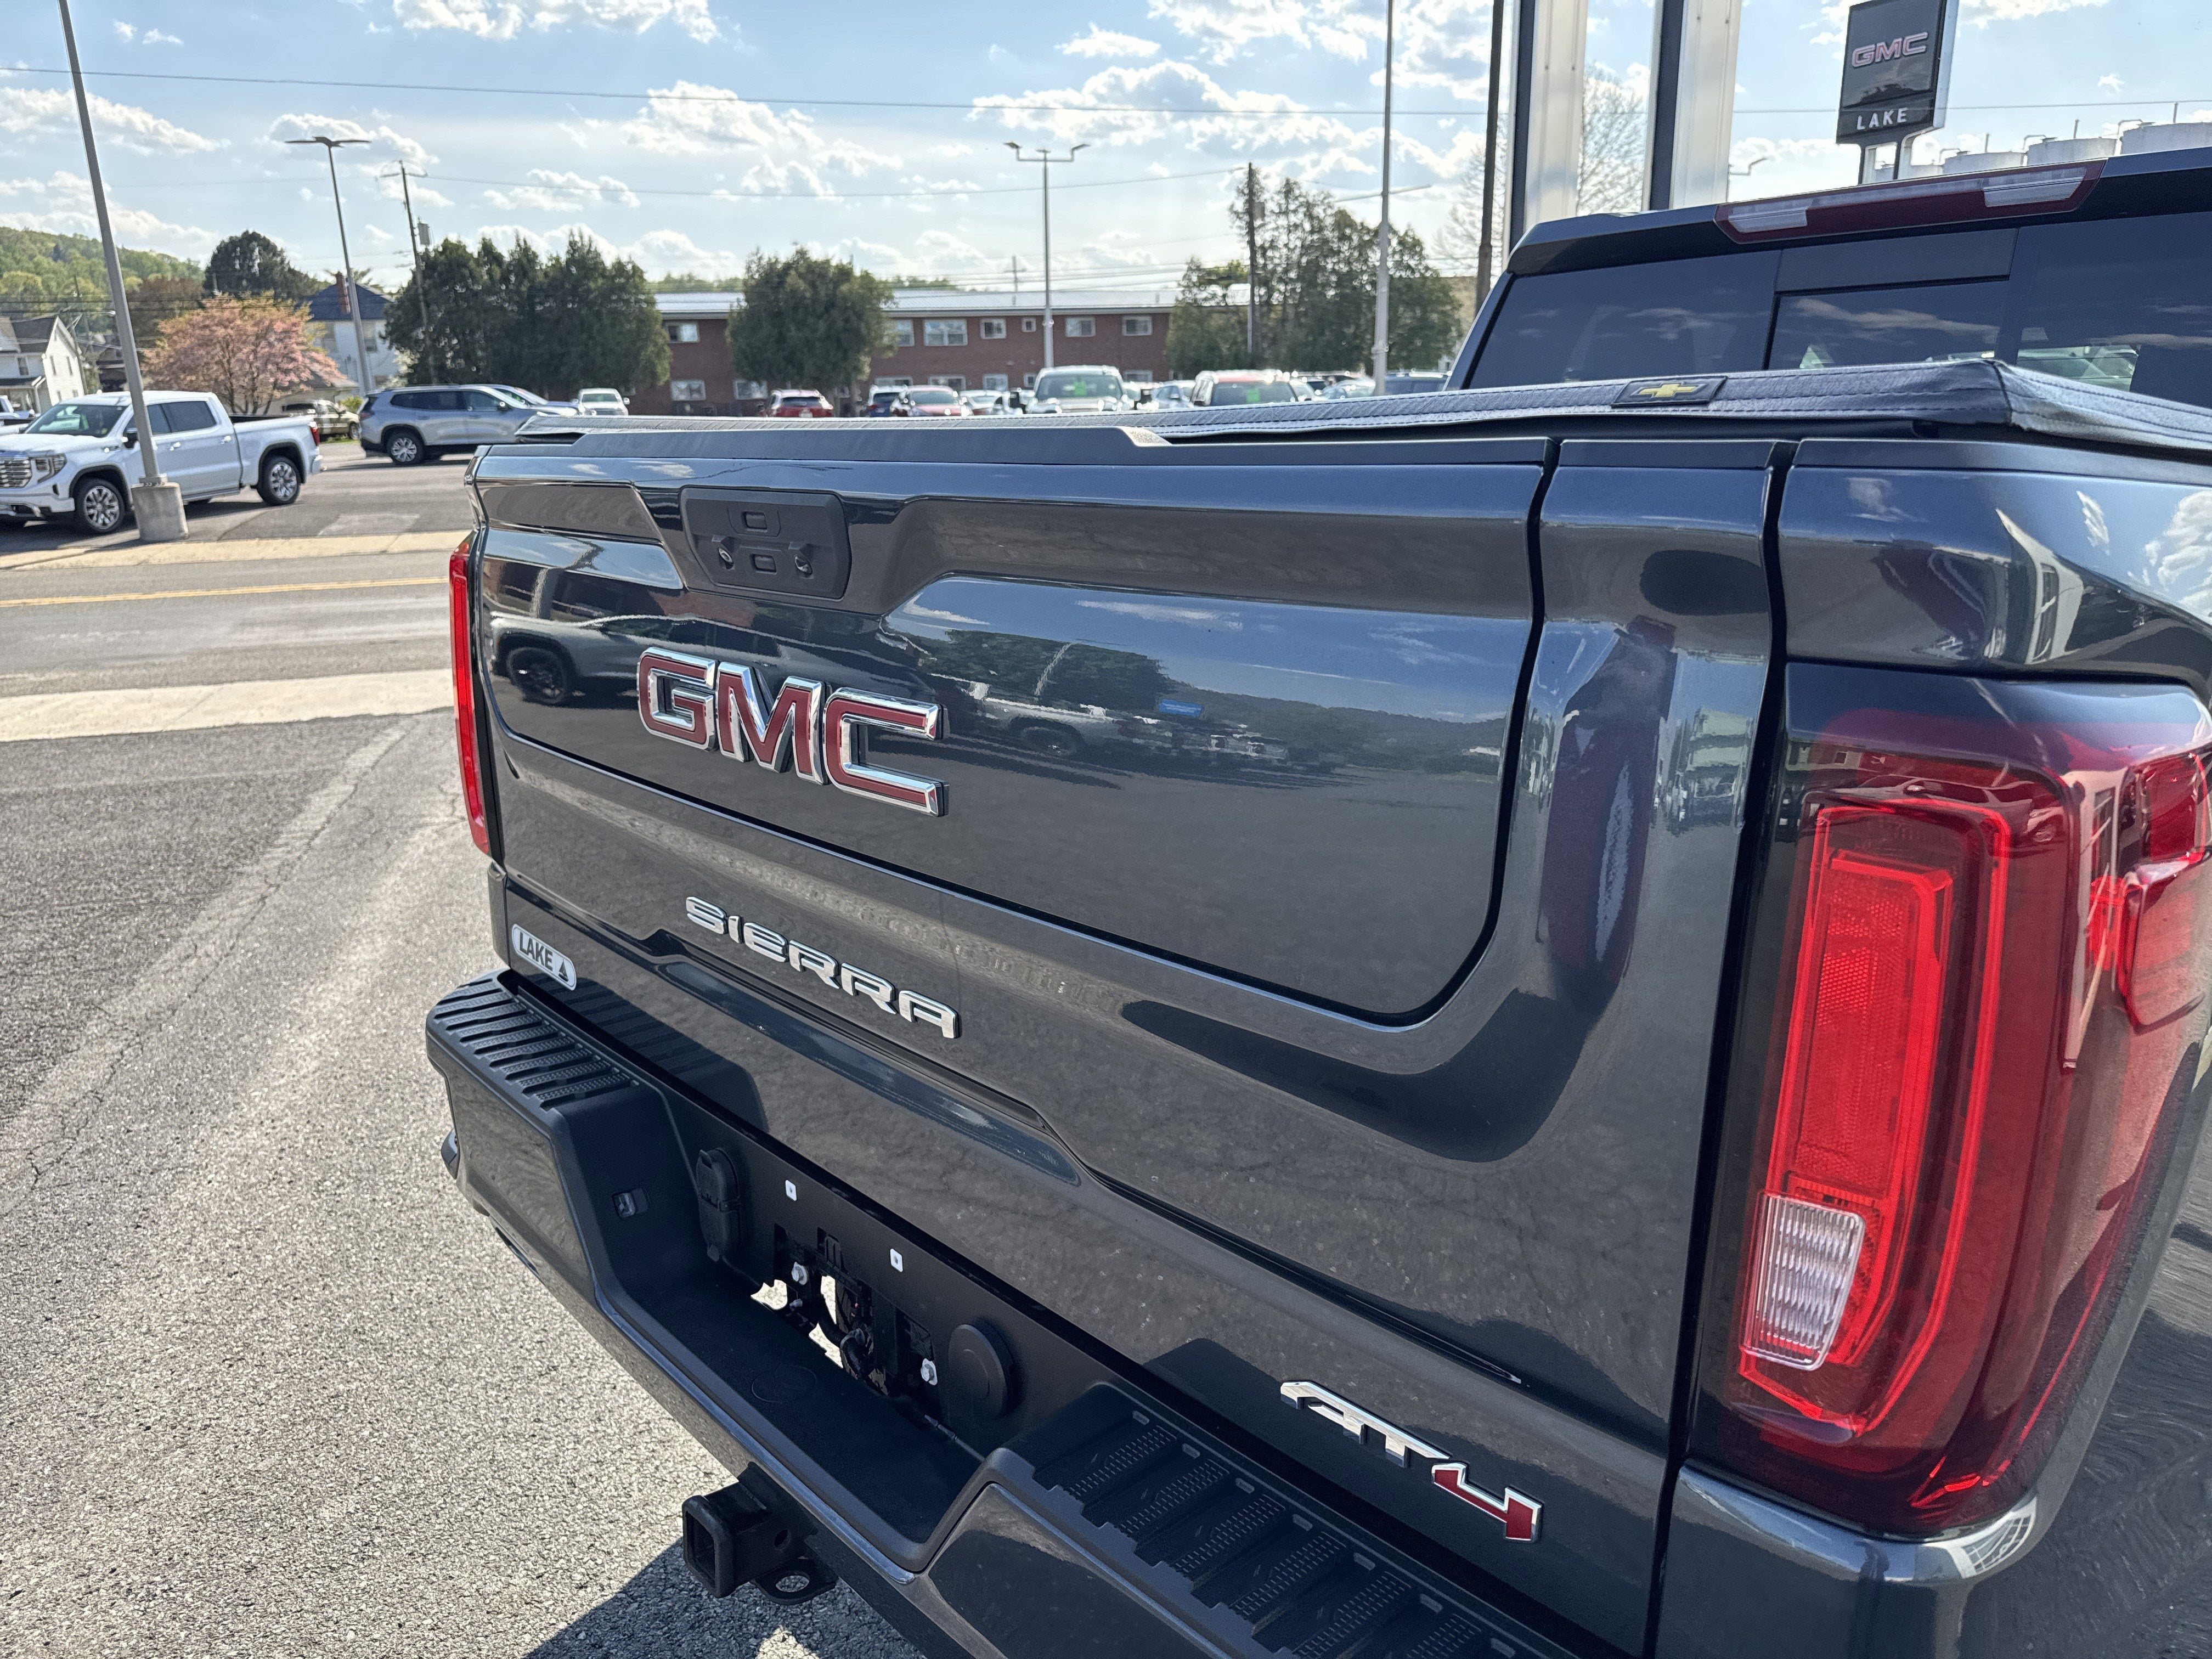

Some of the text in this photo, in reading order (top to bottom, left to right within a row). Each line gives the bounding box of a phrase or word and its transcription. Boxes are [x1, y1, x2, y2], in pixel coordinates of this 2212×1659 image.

[1852, 32, 1928, 67] GMC
[1857, 108, 1908, 130] LAKE
[637, 646, 947, 816] GMC
[520, 932, 553, 972] LAKE
[686, 896, 960, 1039] SIERRA
[1280, 1381, 1542, 1542] AT4
